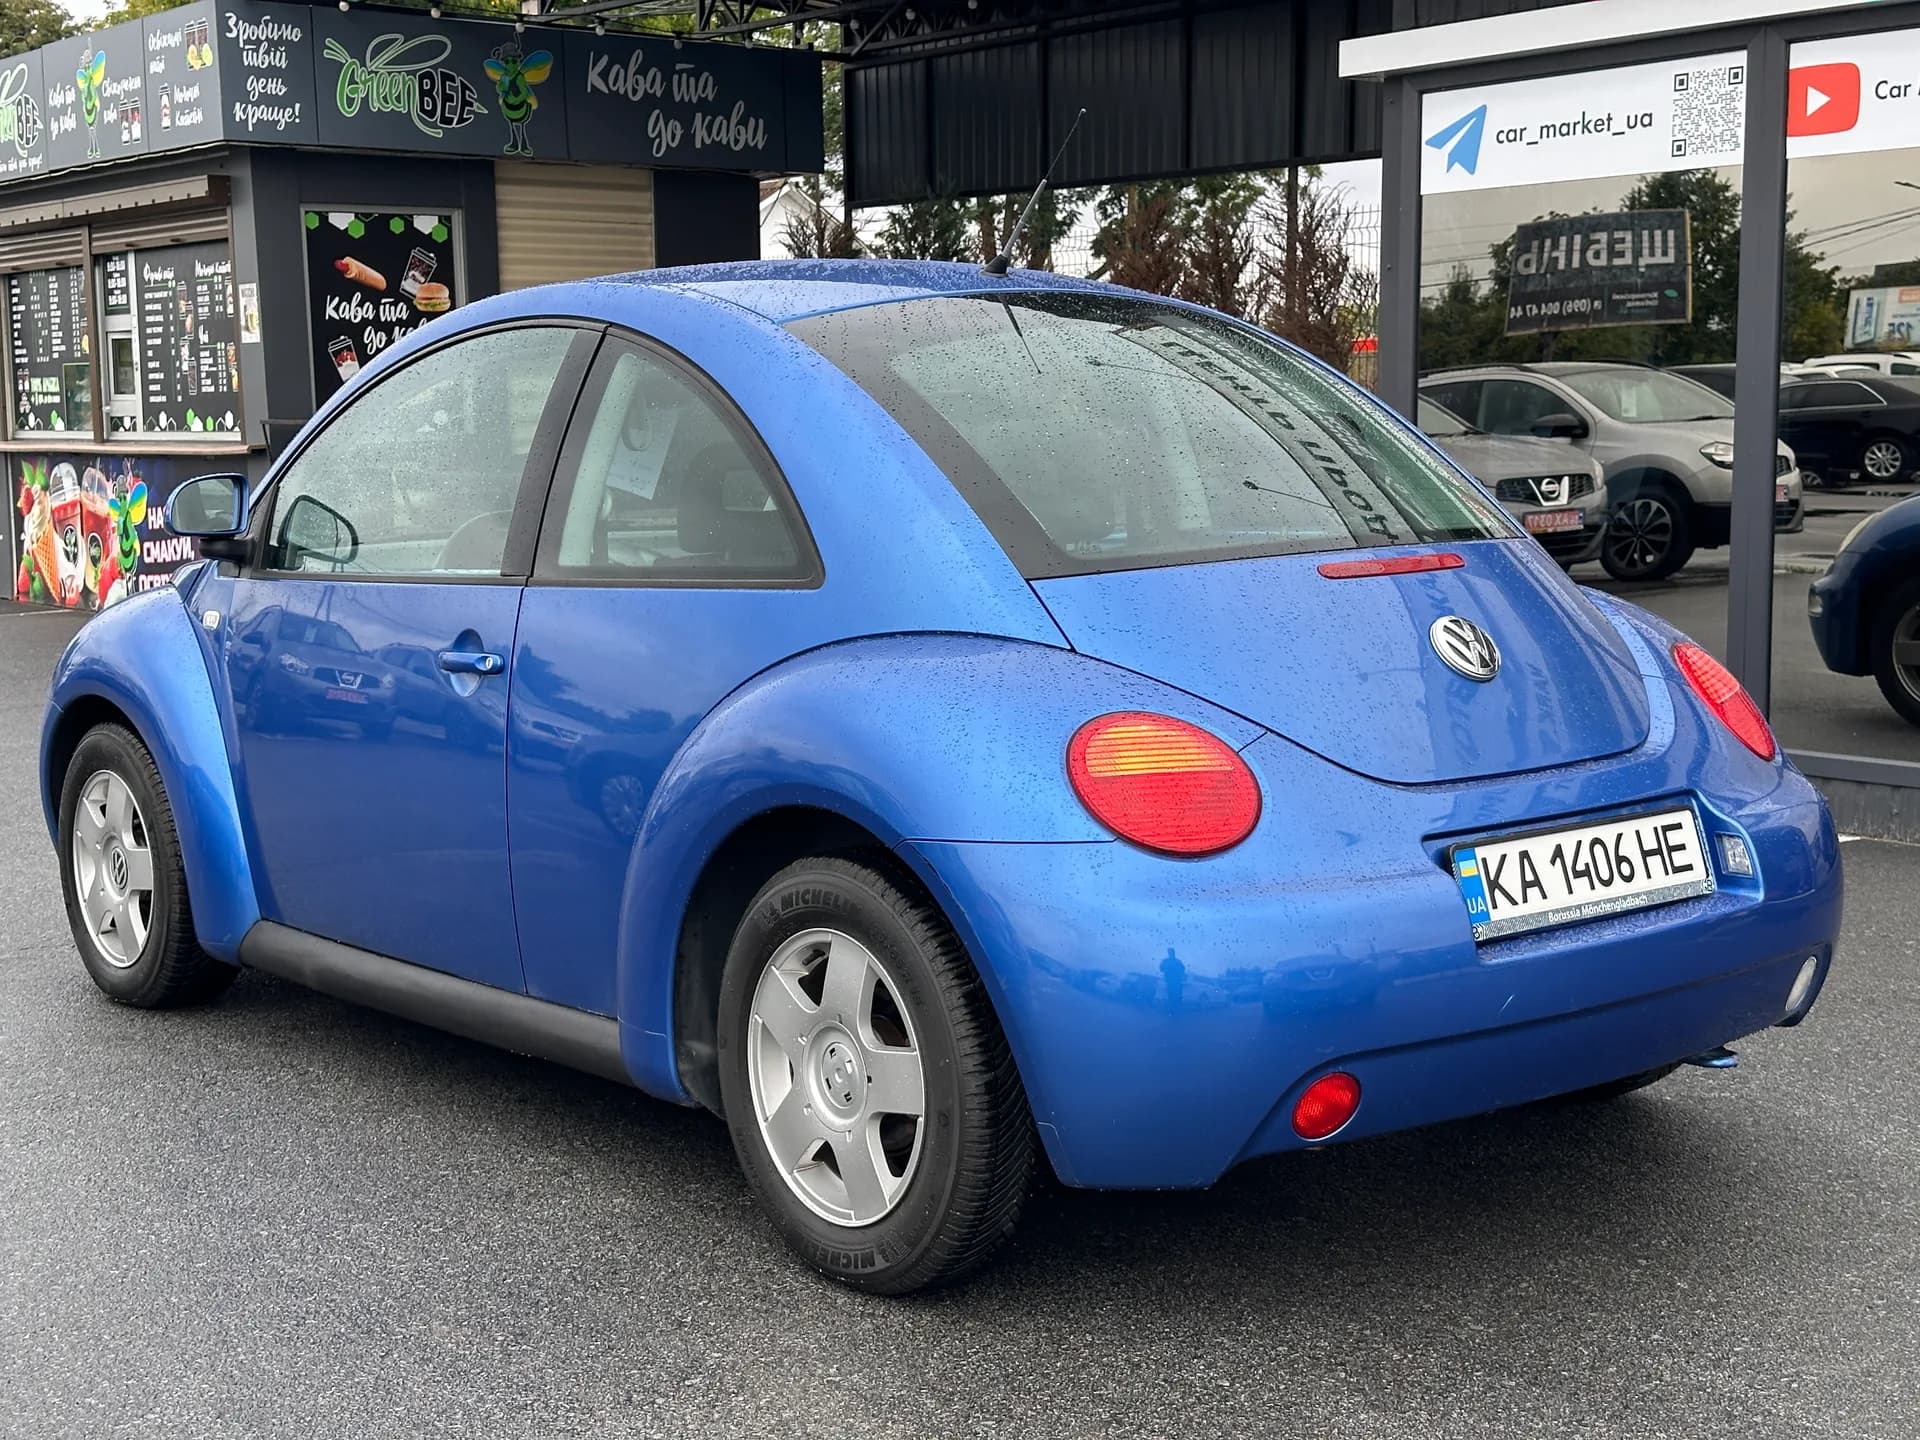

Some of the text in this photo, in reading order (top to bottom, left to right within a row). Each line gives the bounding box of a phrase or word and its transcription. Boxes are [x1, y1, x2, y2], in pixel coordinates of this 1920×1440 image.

[225, 12, 302, 48] Зробимо
[242, 41, 288, 69] твій
[246, 75, 288, 101] день
[587, 49, 718, 103] Кава та
[1875, 80, 1912, 100] Car
[233, 102, 301, 132] краще!
[647, 100, 768, 157] до кави
[1496, 111, 1653, 146] car_market_ua
[325, 292, 410, 323] Кава та
[363, 326, 388, 355] до
[1481, 822, 1694, 909] KA 1406 HE
[1466, 895, 1487, 914] UA
[1548, 894, 1649, 922] Borussia Mönchengladbach
